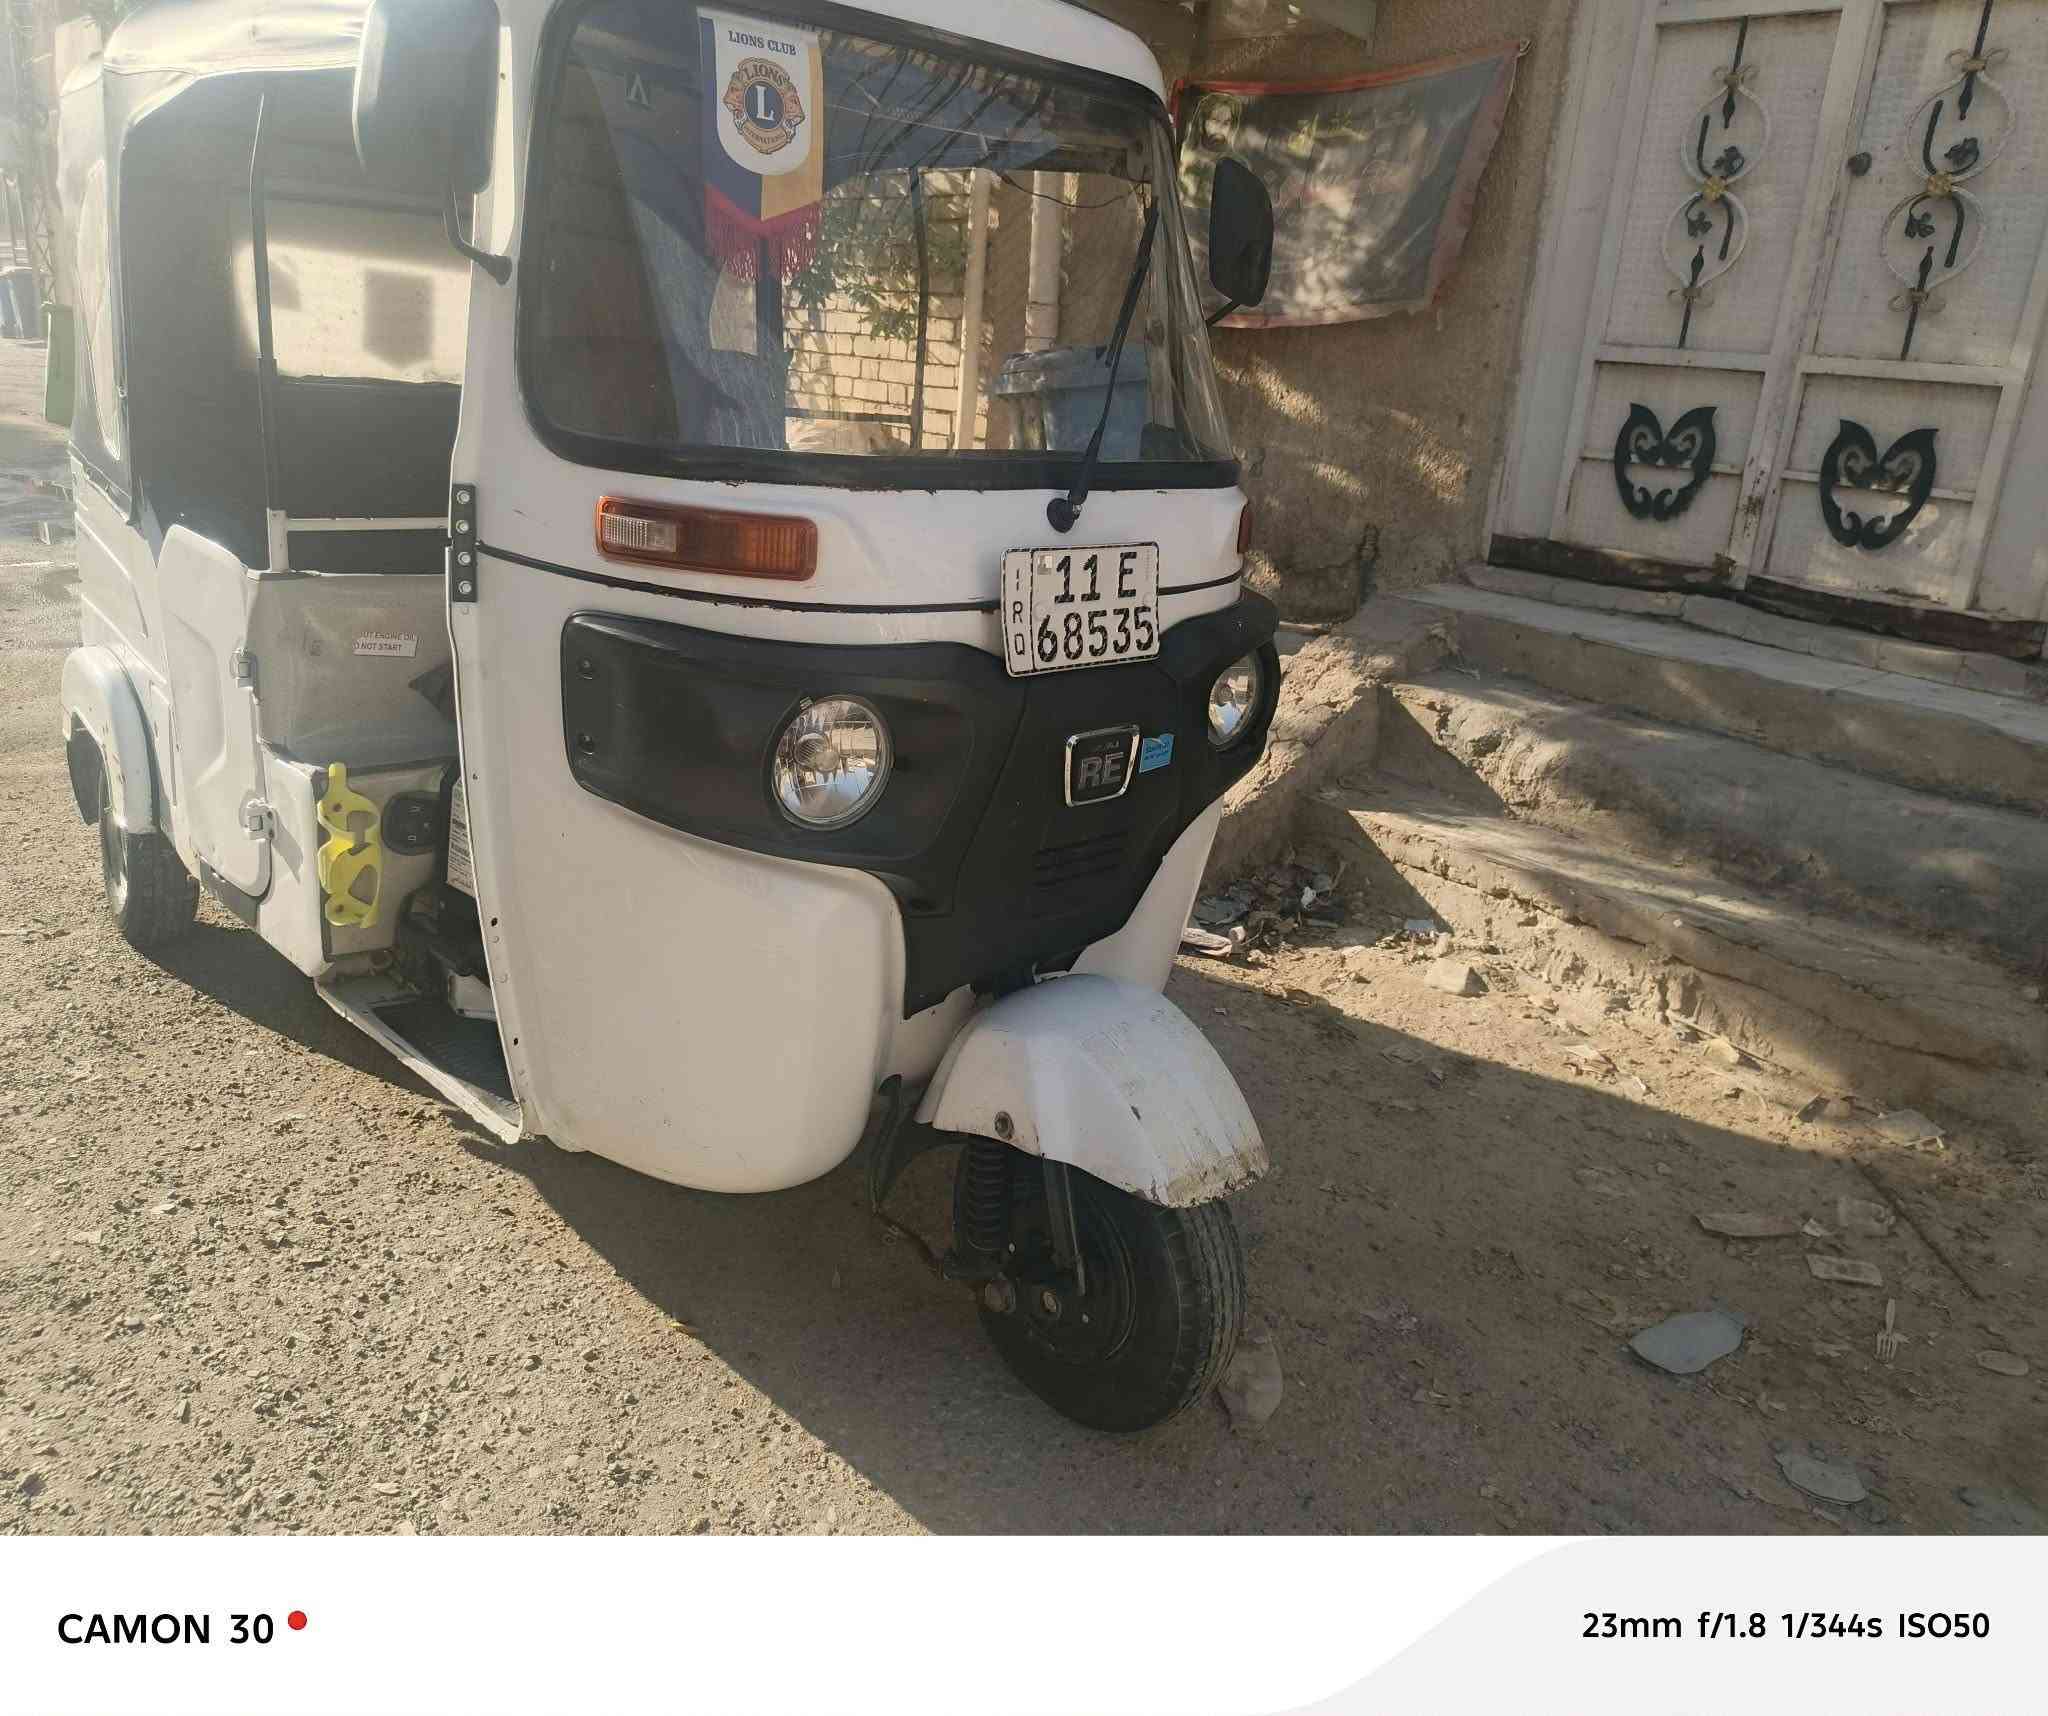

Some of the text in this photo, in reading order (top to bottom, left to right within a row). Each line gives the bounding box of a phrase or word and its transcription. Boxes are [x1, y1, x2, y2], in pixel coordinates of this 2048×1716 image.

[728, 30, 797, 56] LIONS CLUB
[740, 63, 786, 86] LIONS
[755, 86, 775, 121] L
[1054, 554, 1102, 604] 11
[1117, 551, 1138, 599] E
[361, 640, 376, 651] NOT
[377, 642, 402, 652] START
[1037, 605, 1155, 663] 68535
[1078, 751, 1125, 790] RE
